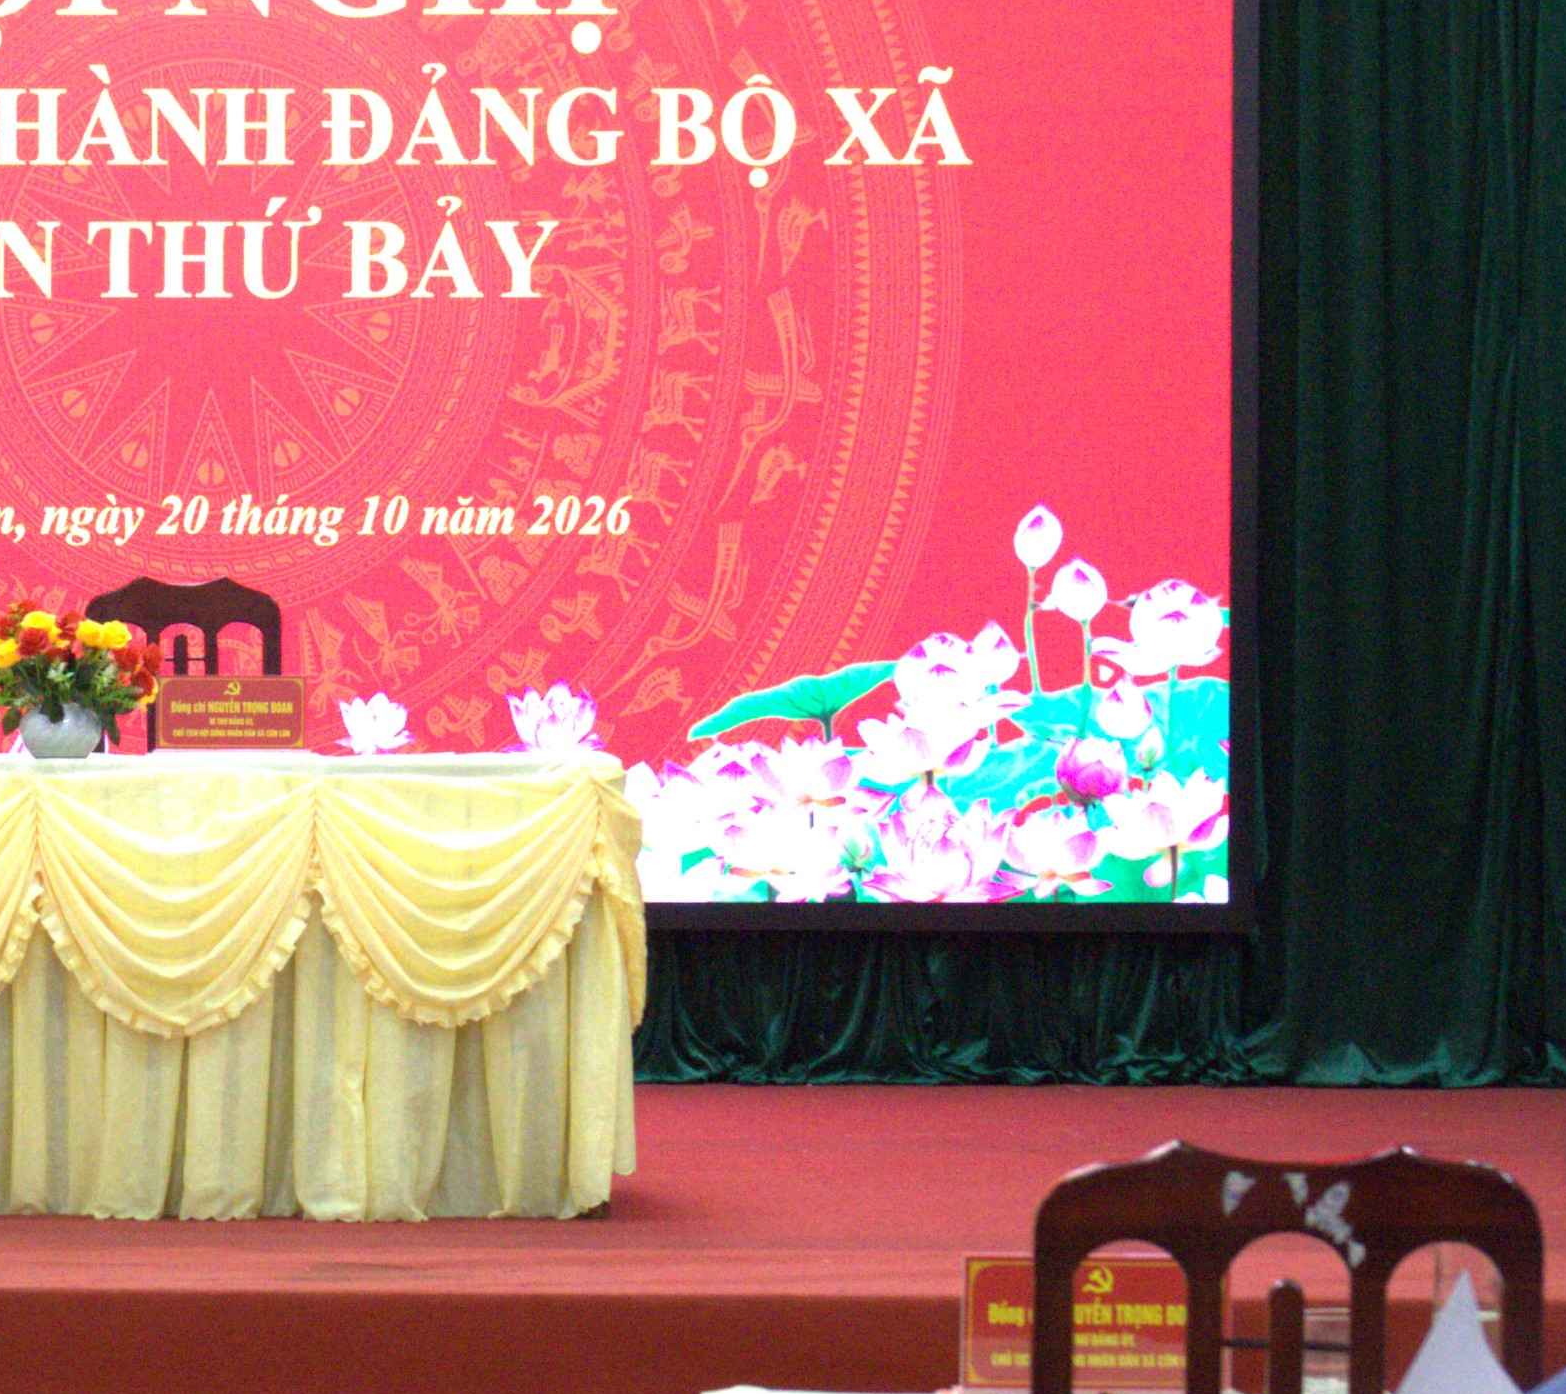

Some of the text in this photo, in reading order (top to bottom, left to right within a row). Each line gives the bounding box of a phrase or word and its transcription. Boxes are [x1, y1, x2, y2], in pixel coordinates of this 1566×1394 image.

[321, 62, 624, 167] ĐẢNG
[650, 74, 796, 188] BỘ
[824, 66, 972, 165] XÃ
[87, 196, 323, 299] THỨ
[342, 195, 559, 299] BẢY
[40, 493, 145, 547] ngày
[156, 494, 209, 535] 20
[220, 494, 345, 547] tháng
[357, 495, 409, 535] 10
[420, 496, 515, 535] năm
[526, 495, 632, 535] 2026
